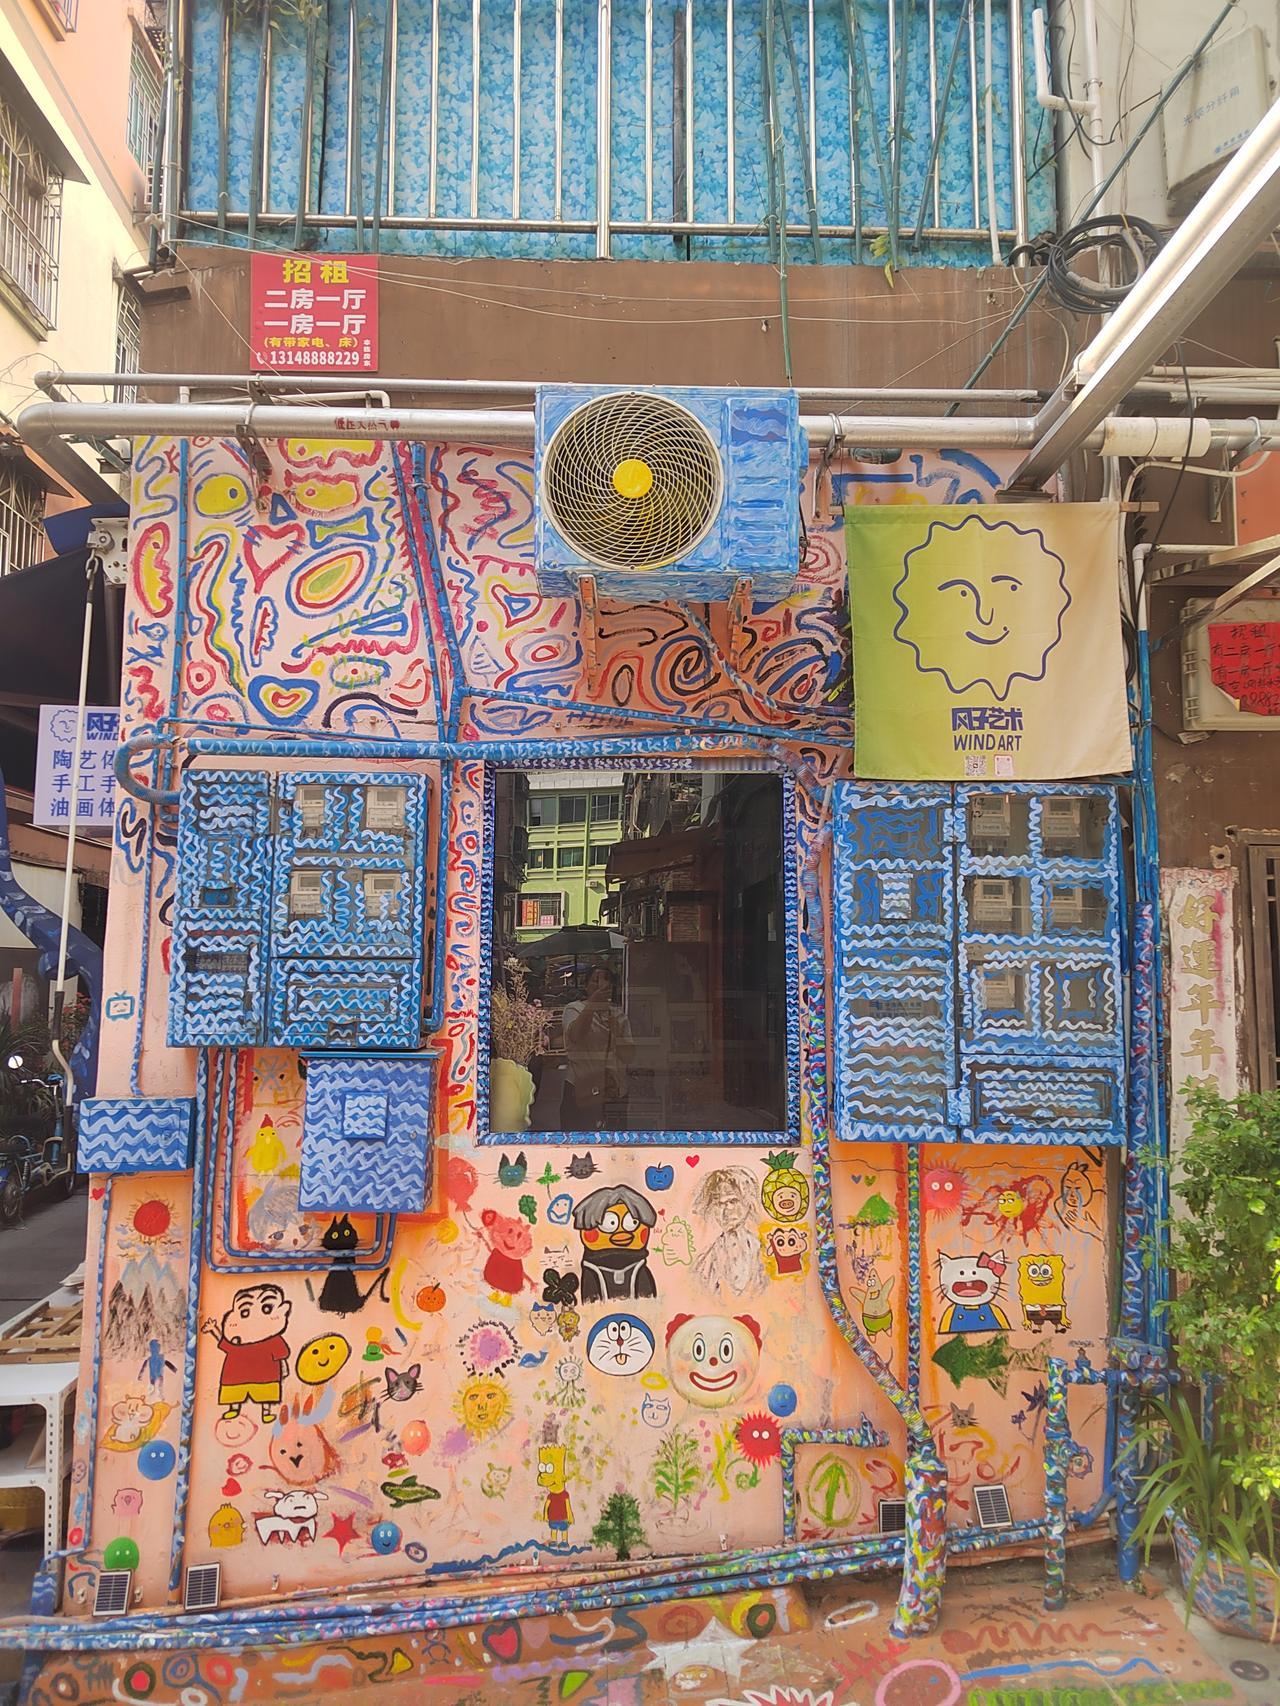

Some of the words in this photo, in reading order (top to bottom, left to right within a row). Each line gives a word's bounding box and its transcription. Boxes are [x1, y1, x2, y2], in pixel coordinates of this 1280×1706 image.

[283, 259, 349, 284] 招租
[264, 288, 366, 310] 二房一厅
[264, 313, 366, 335] 一房一厅
[270, 351, 359, 365] 13148888229
[953, 734, 996, 751] WIND
[997, 735, 1023, 751] ART
